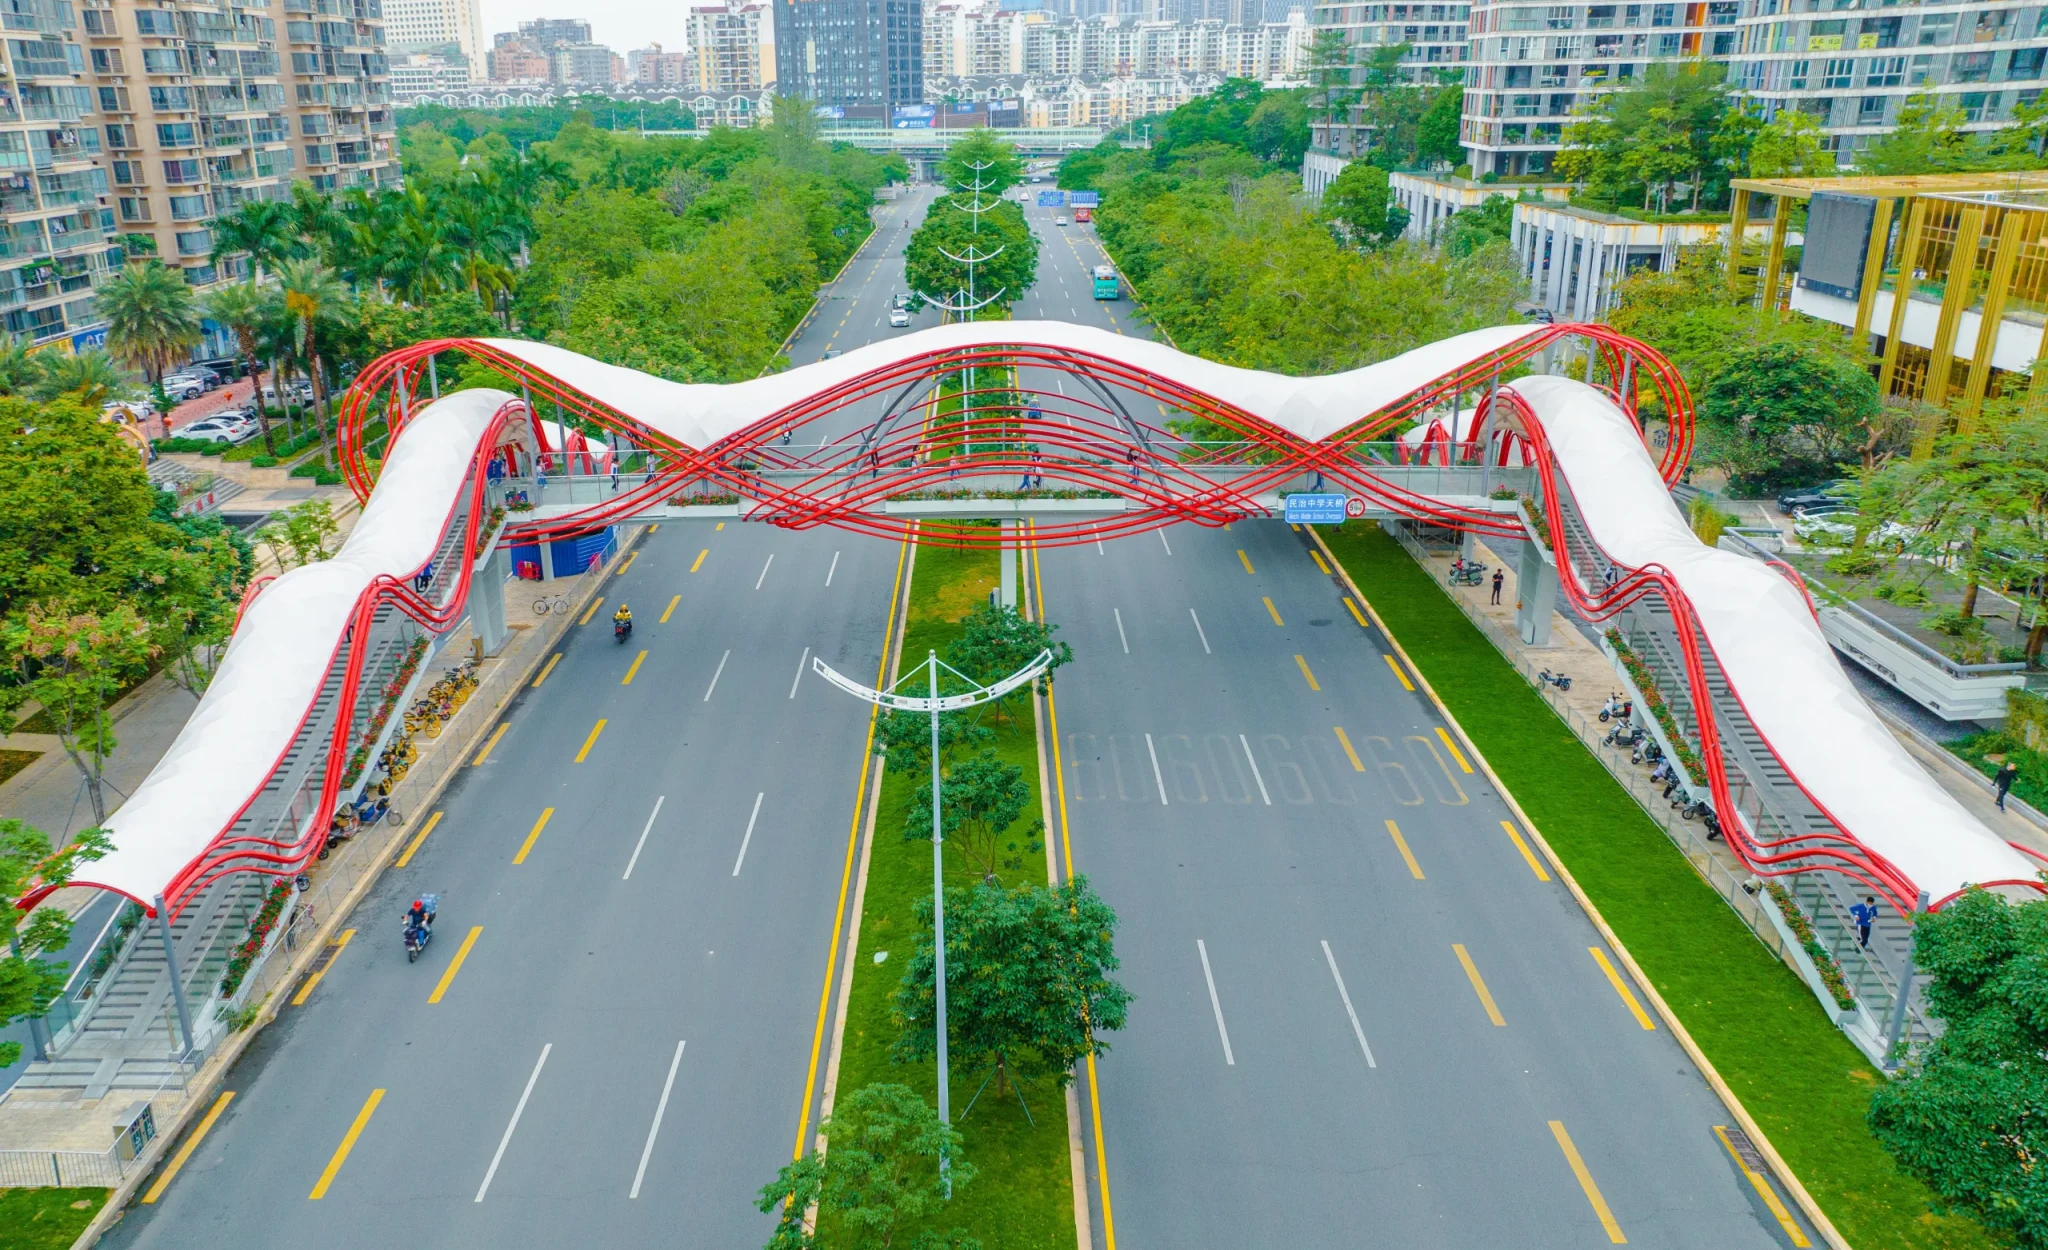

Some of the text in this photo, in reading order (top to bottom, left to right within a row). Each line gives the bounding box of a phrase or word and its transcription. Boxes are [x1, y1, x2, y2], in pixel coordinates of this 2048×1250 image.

[1289, 499, 1344, 508] 民治中学天桥
[1163, 733, 1253, 804] 60
[1362, 735, 1471, 807] 60
